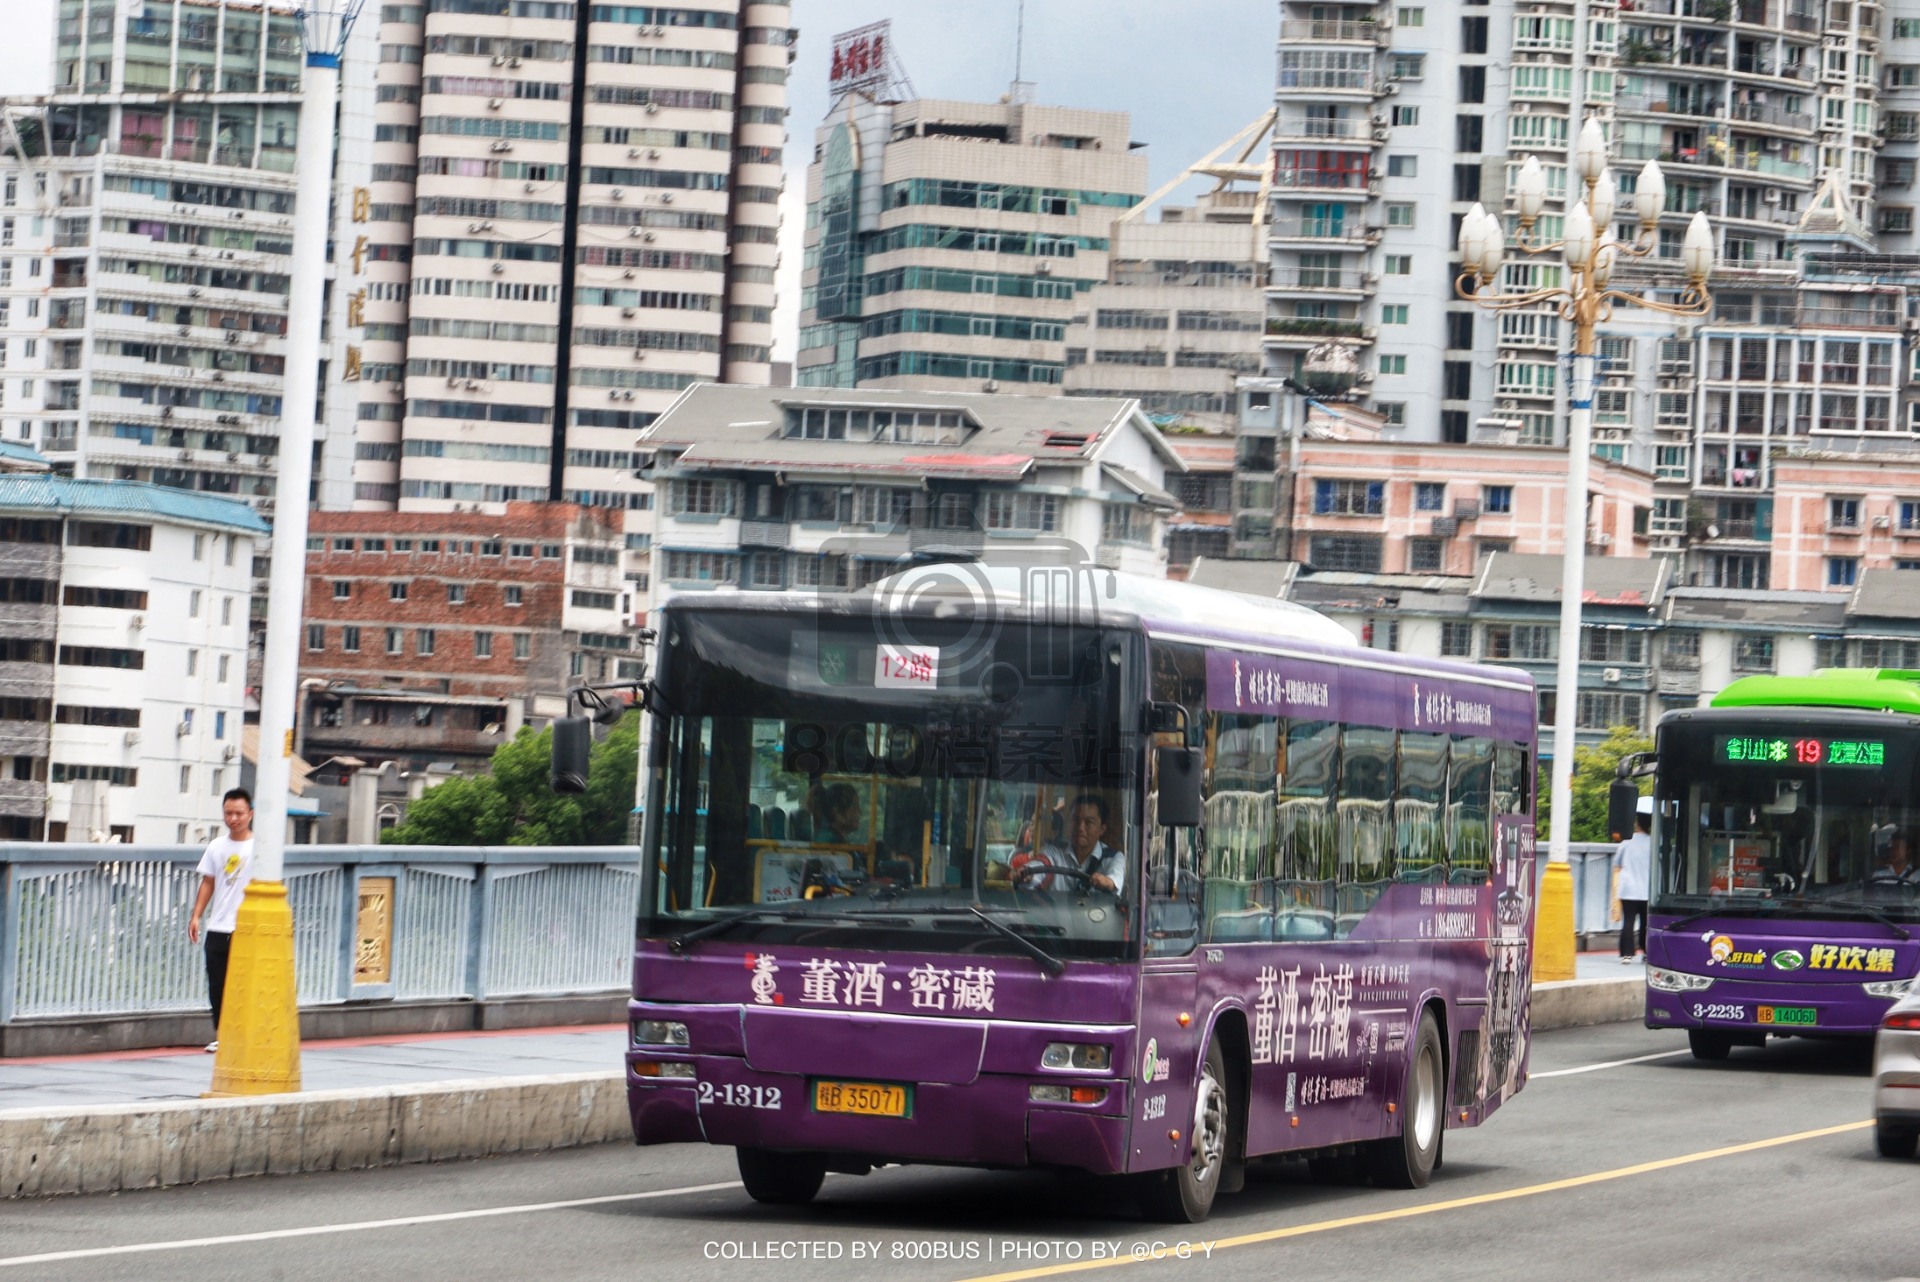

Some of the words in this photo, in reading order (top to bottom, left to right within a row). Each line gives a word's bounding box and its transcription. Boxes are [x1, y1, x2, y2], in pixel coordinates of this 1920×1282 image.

[881, 653, 932, 682] 12路
[1795, 739, 1821, 763] 19
[1827, 741, 1884, 765] 龙潭公园
[1808, 943, 1896, 973] 好欢螺
[1693, 1003, 1745, 1020] 3-2235
[1778, 1010, 1815, 1023] 14006D
[698, 1081, 782, 1110] 2-1312
[847, 1087, 900, 1112] 35071
[1142, 1094, 1167, 1121] 2-1312
